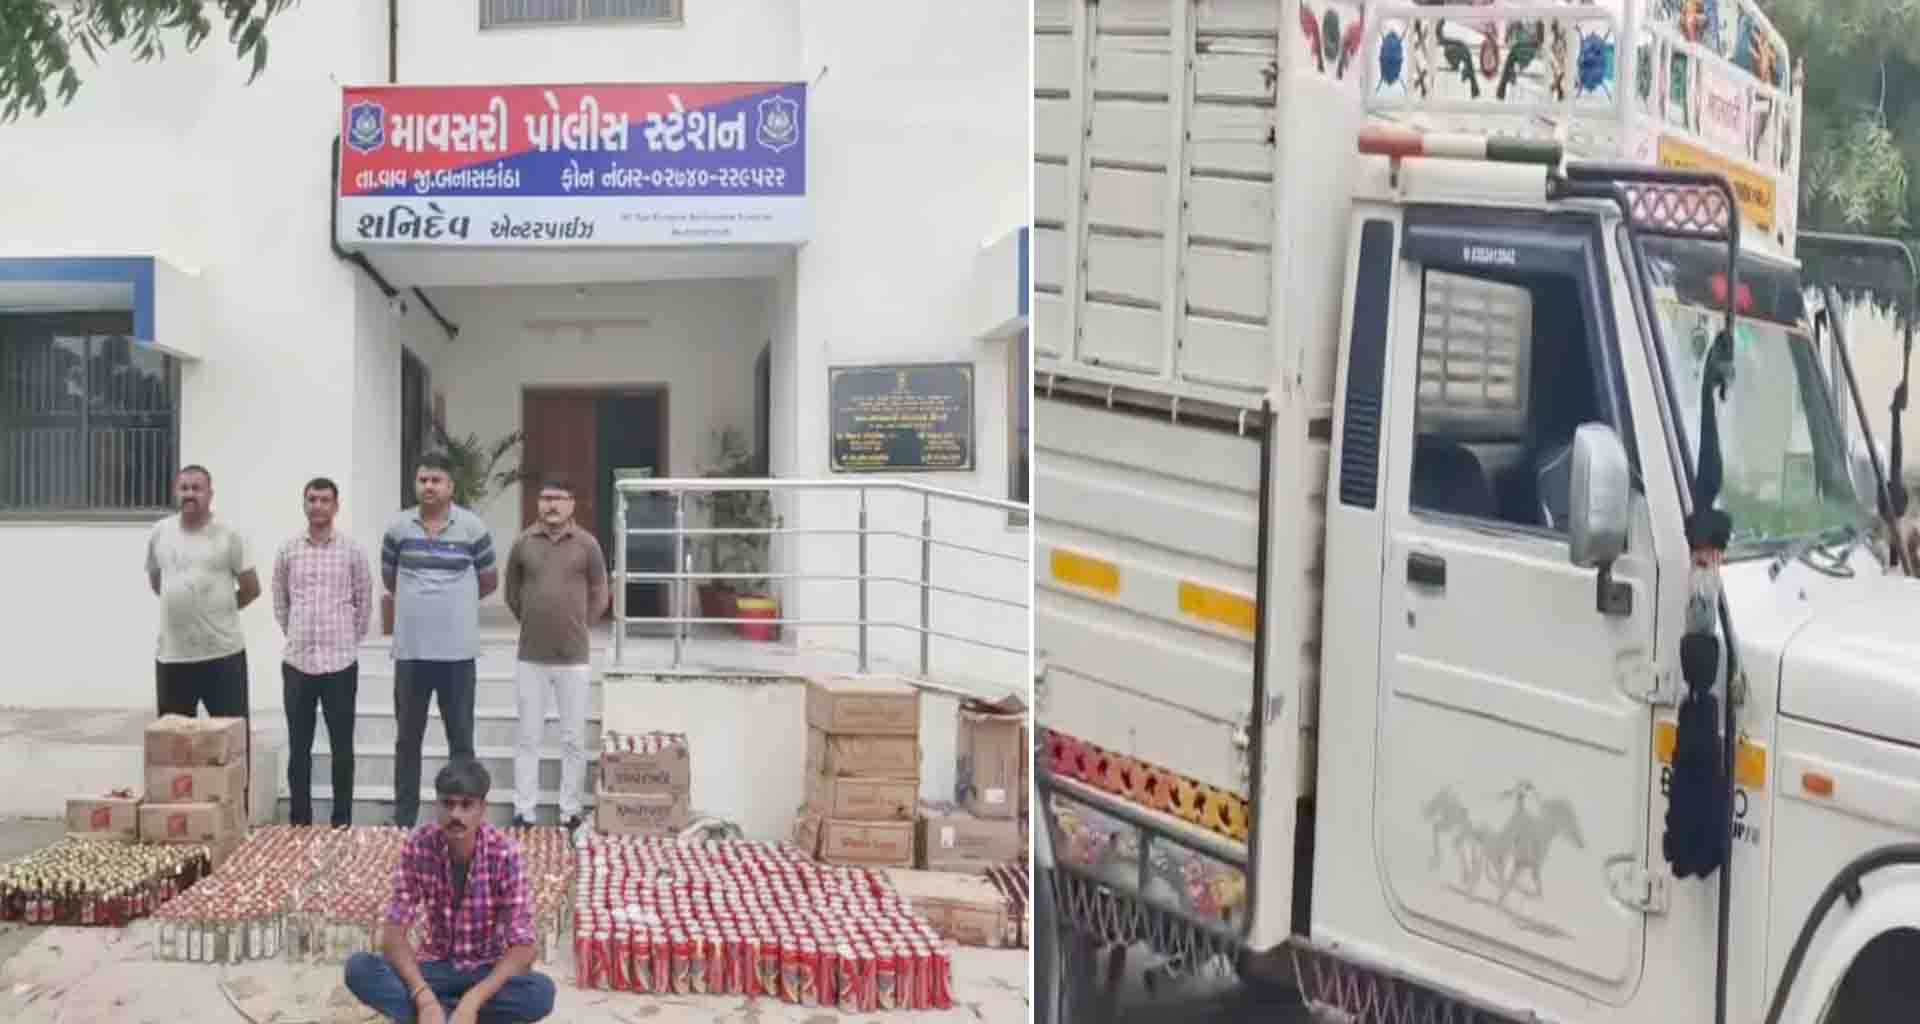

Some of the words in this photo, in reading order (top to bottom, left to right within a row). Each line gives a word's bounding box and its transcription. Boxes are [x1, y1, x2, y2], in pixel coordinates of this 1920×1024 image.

[391, 95, 508, 152] માવસરી
[523, 89, 629, 152] પોલીસ
[644, 92, 746, 151] સ્ટેશન
[355, 167, 407, 189] તા.વાવ
[560, 159, 595, 192] ફોન
[357, 202, 470, 240] શનિદેવ
